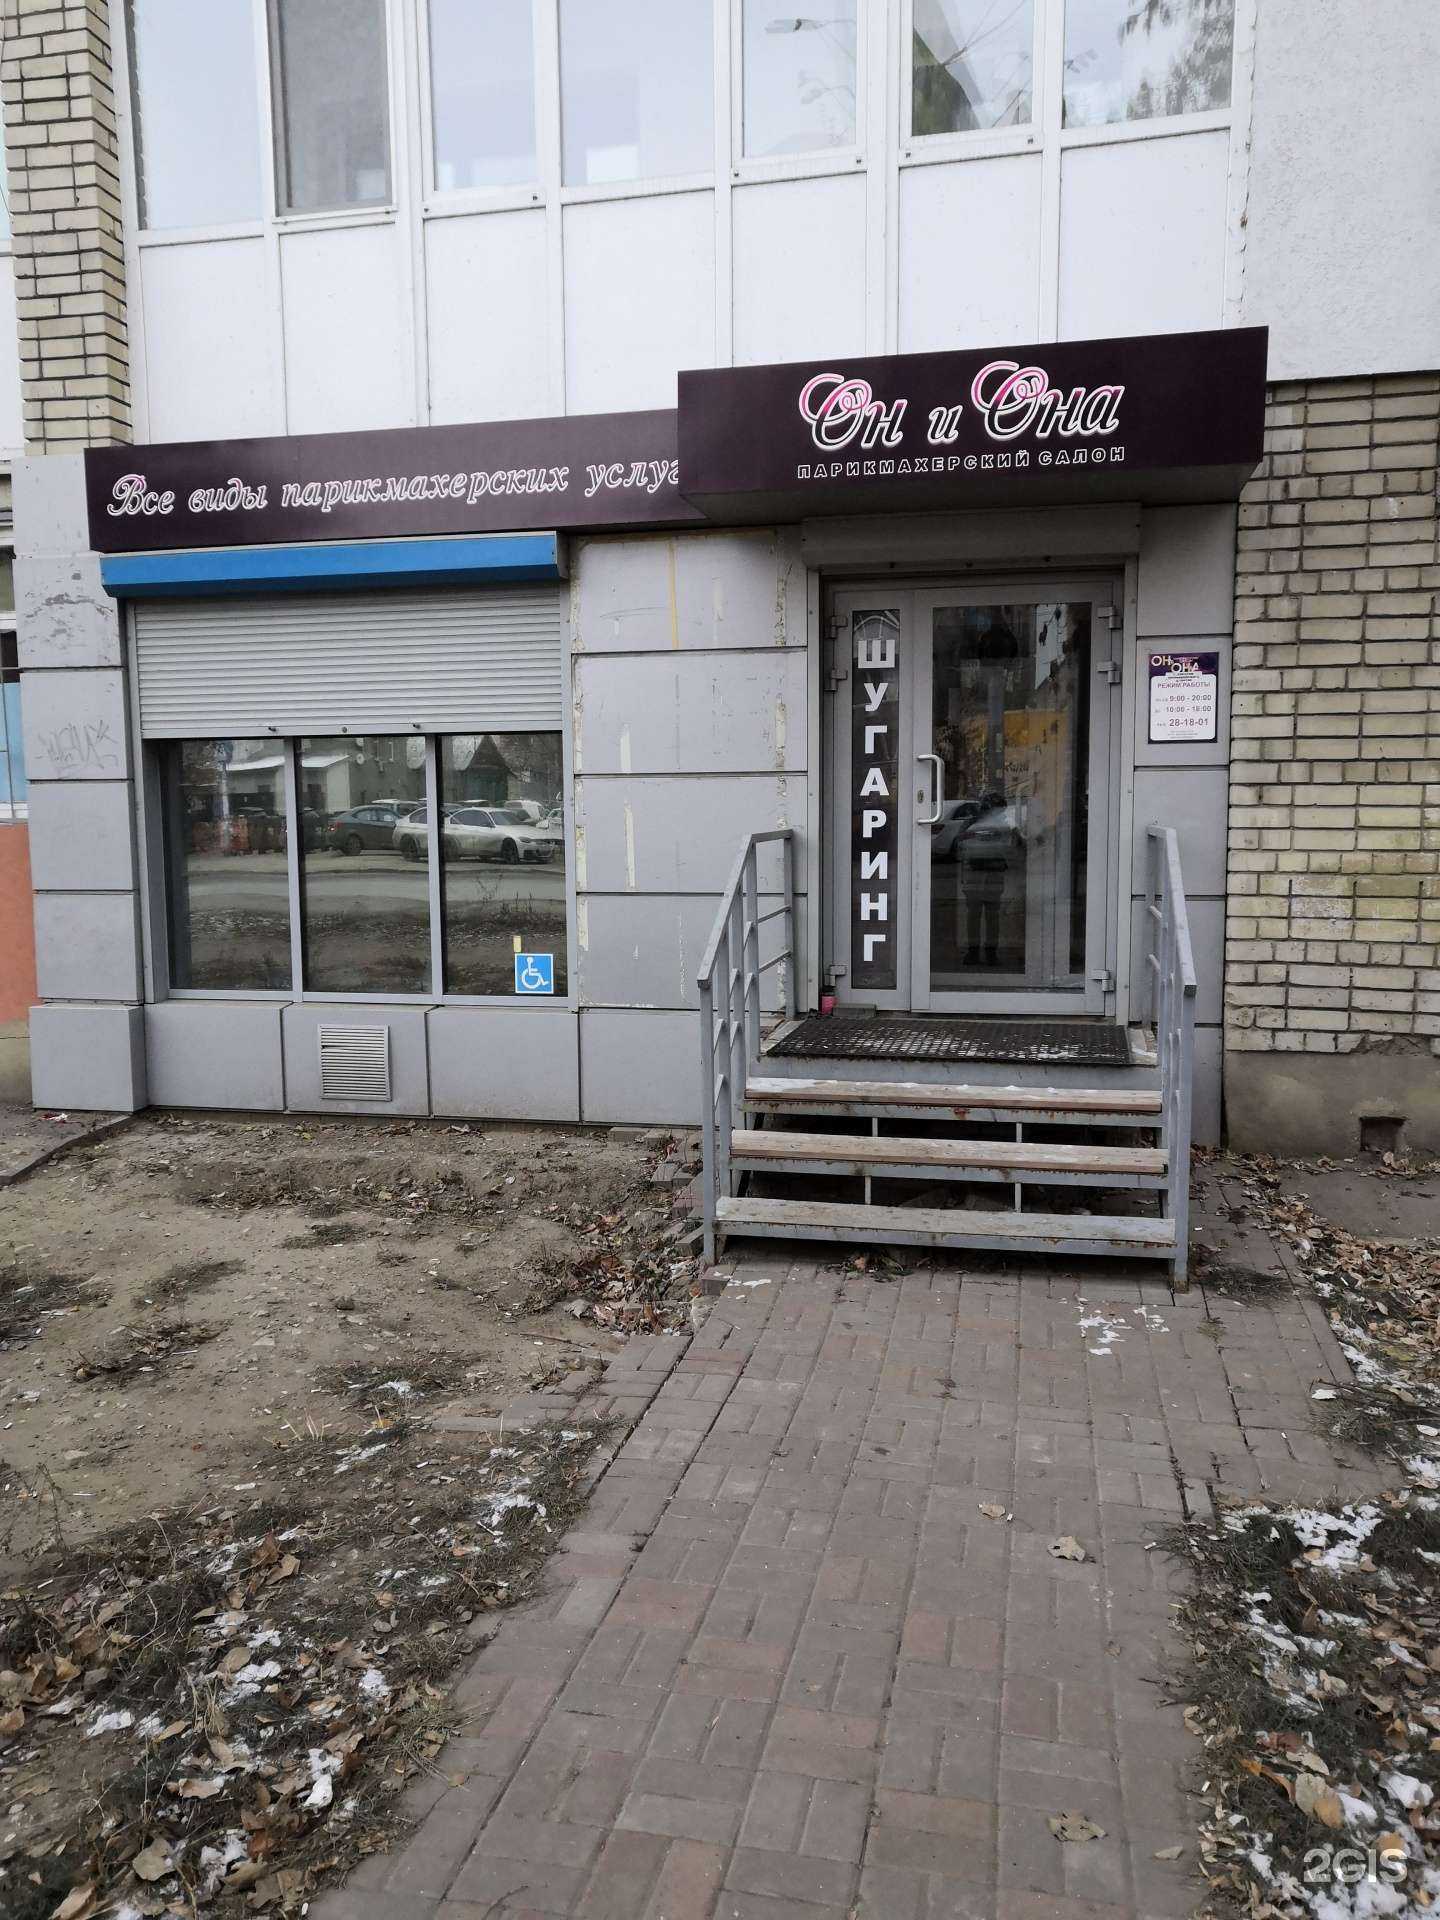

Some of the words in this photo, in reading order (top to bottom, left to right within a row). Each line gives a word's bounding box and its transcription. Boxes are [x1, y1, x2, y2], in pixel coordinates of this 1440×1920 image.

[799, 373, 907, 450] Он
[927, 405, 963, 444] и
[971, 360, 1125, 441] Она
[797, 450, 1030, 479] ПАРИКМАХЕРСКИЙ
[1038, 447, 1125, 466] САЛОН
[107, 473, 175, 516] Все
[188, 477, 268, 513] виды
[281, 465, 569, 513] парикмахерских
[1169, 718, 1208, 727] 28-18-01
[857, 639, 896, 962] ШУГАРИНГ
